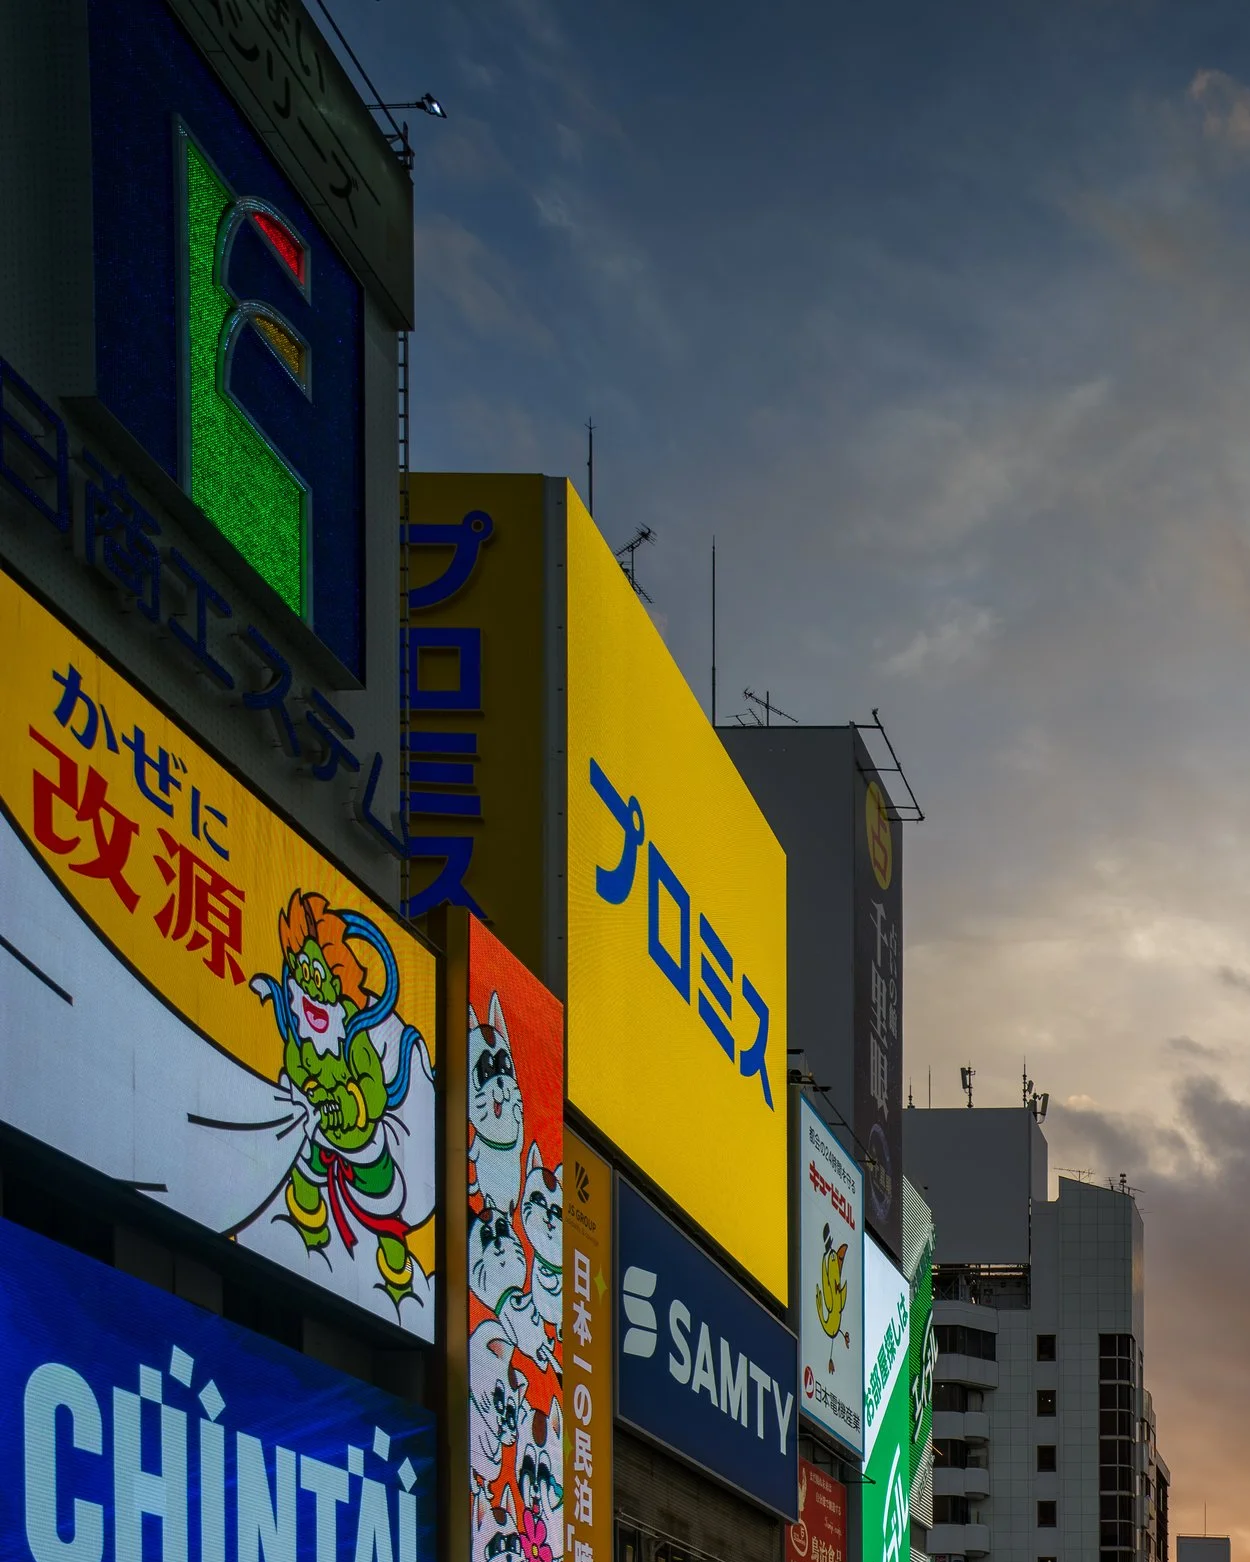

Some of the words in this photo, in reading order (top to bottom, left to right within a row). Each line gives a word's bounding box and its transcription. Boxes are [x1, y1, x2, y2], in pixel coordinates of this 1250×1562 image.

[52, 662, 230, 862] かぜに
[400, 510, 494, 923] プロミス
[28, 724, 247, 986] 改源
[589, 757, 776, 1113] プロミス
[872, 792, 888, 882] 占
[869, 897, 890, 1122] 千里眼
[809, 1160, 856, 1231] キュービクル
[668, 1298, 794, 1456] SAMTY
[865, 1292, 910, 1428] お部屋探しは
